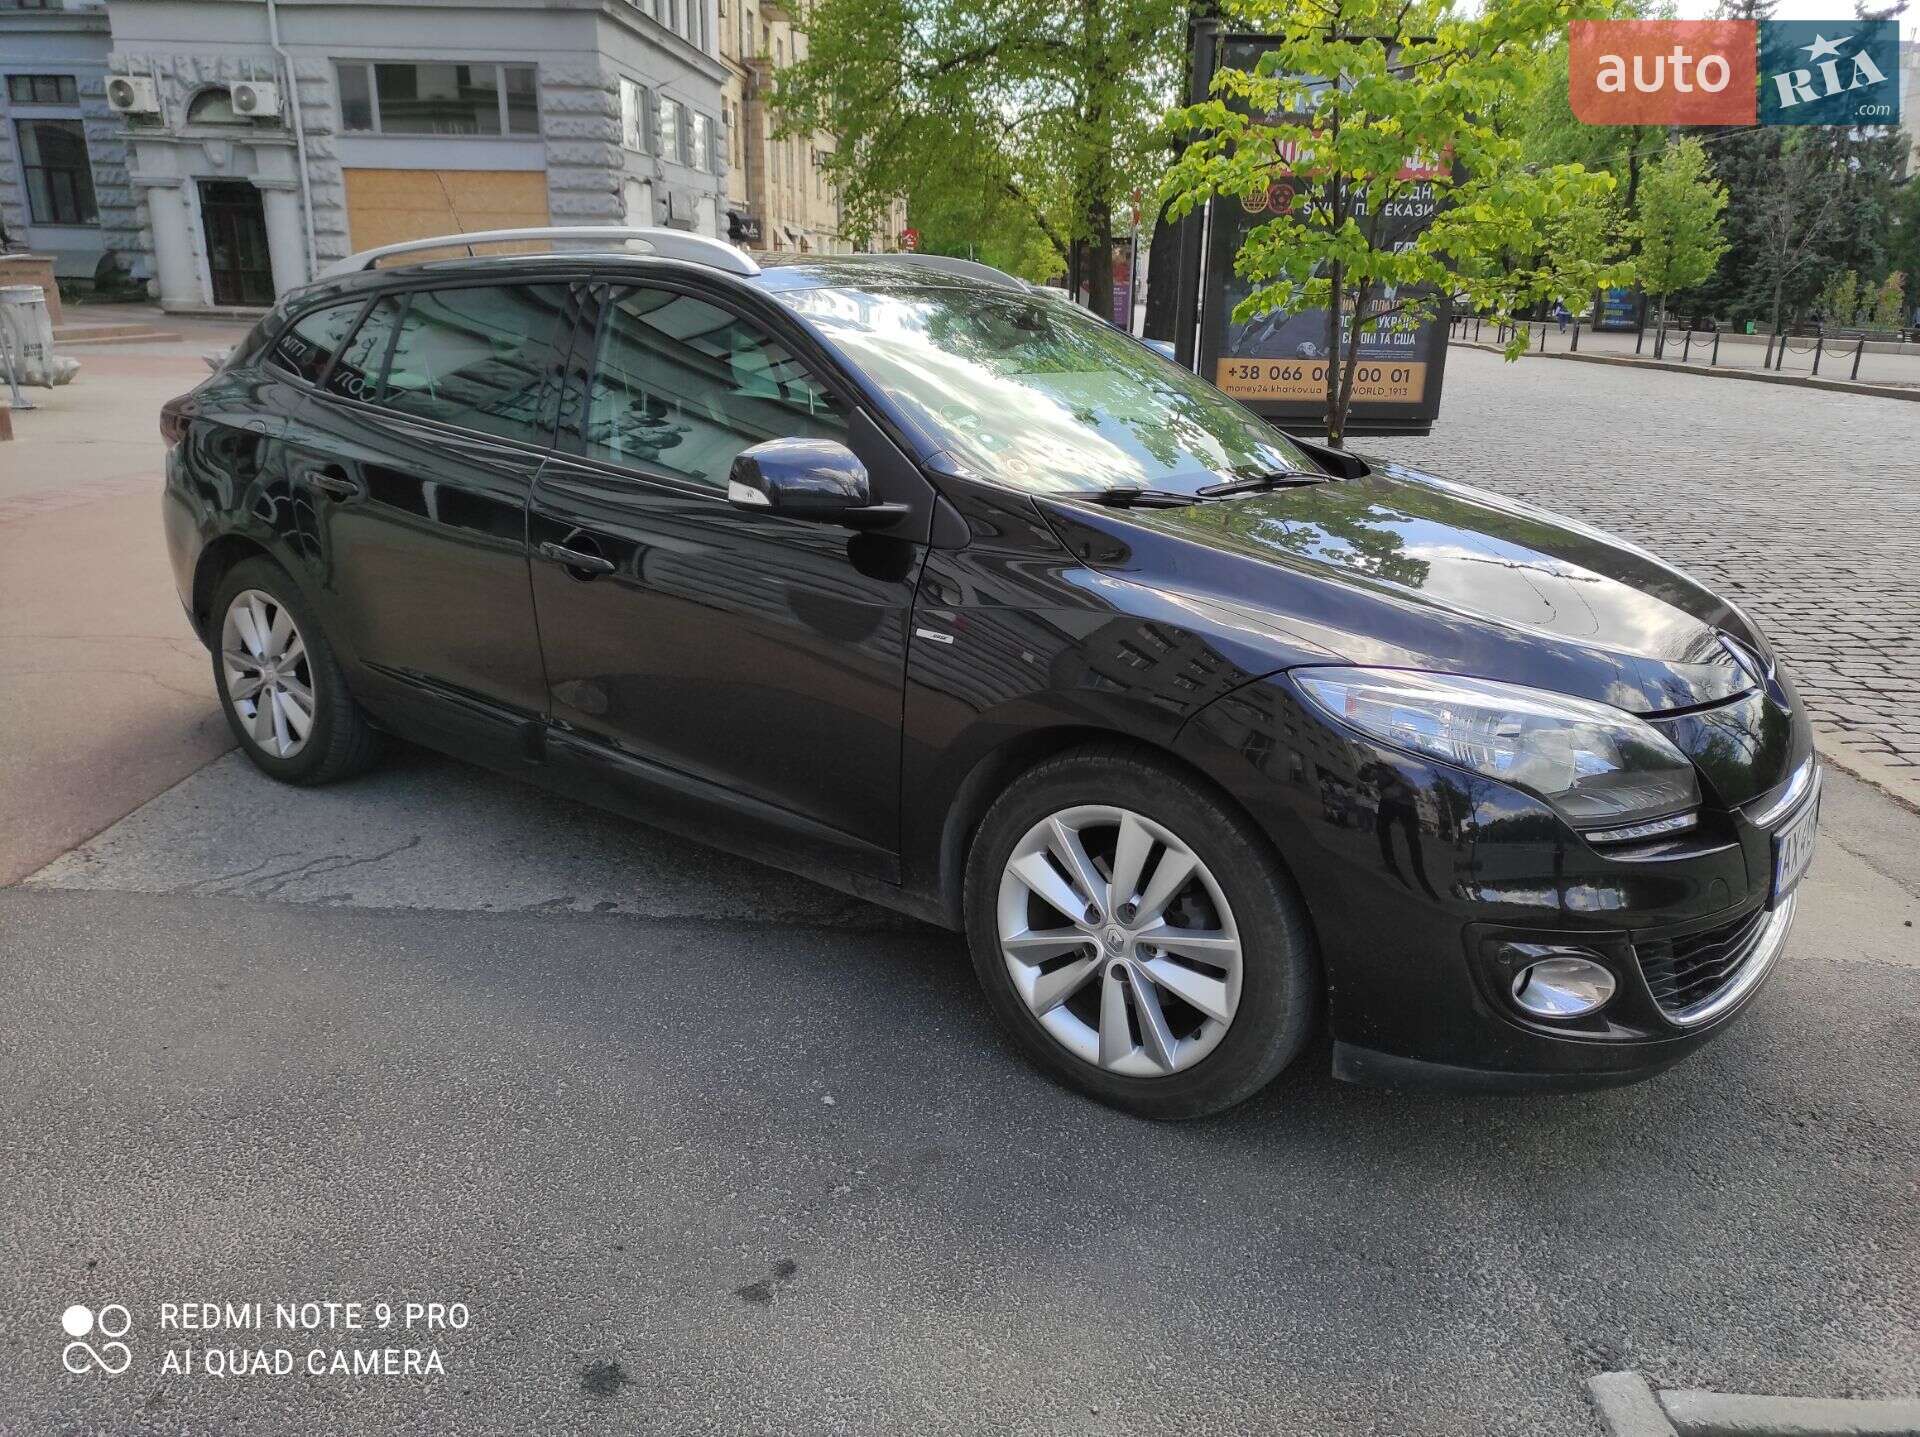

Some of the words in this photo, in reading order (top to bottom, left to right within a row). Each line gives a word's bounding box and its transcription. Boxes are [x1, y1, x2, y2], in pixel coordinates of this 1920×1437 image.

[1380, 333, 1391, 345] ТА
[1394, 333, 1416, 345] США
[1228, 365, 1260, 380] +38
[1269, 366, 1303, 381] 066
[1357, 367, 1382, 382] 00
[1390, 368, 1410, 383] 01
[1226, 385, 1322, 395] money24.kharkov.ua
